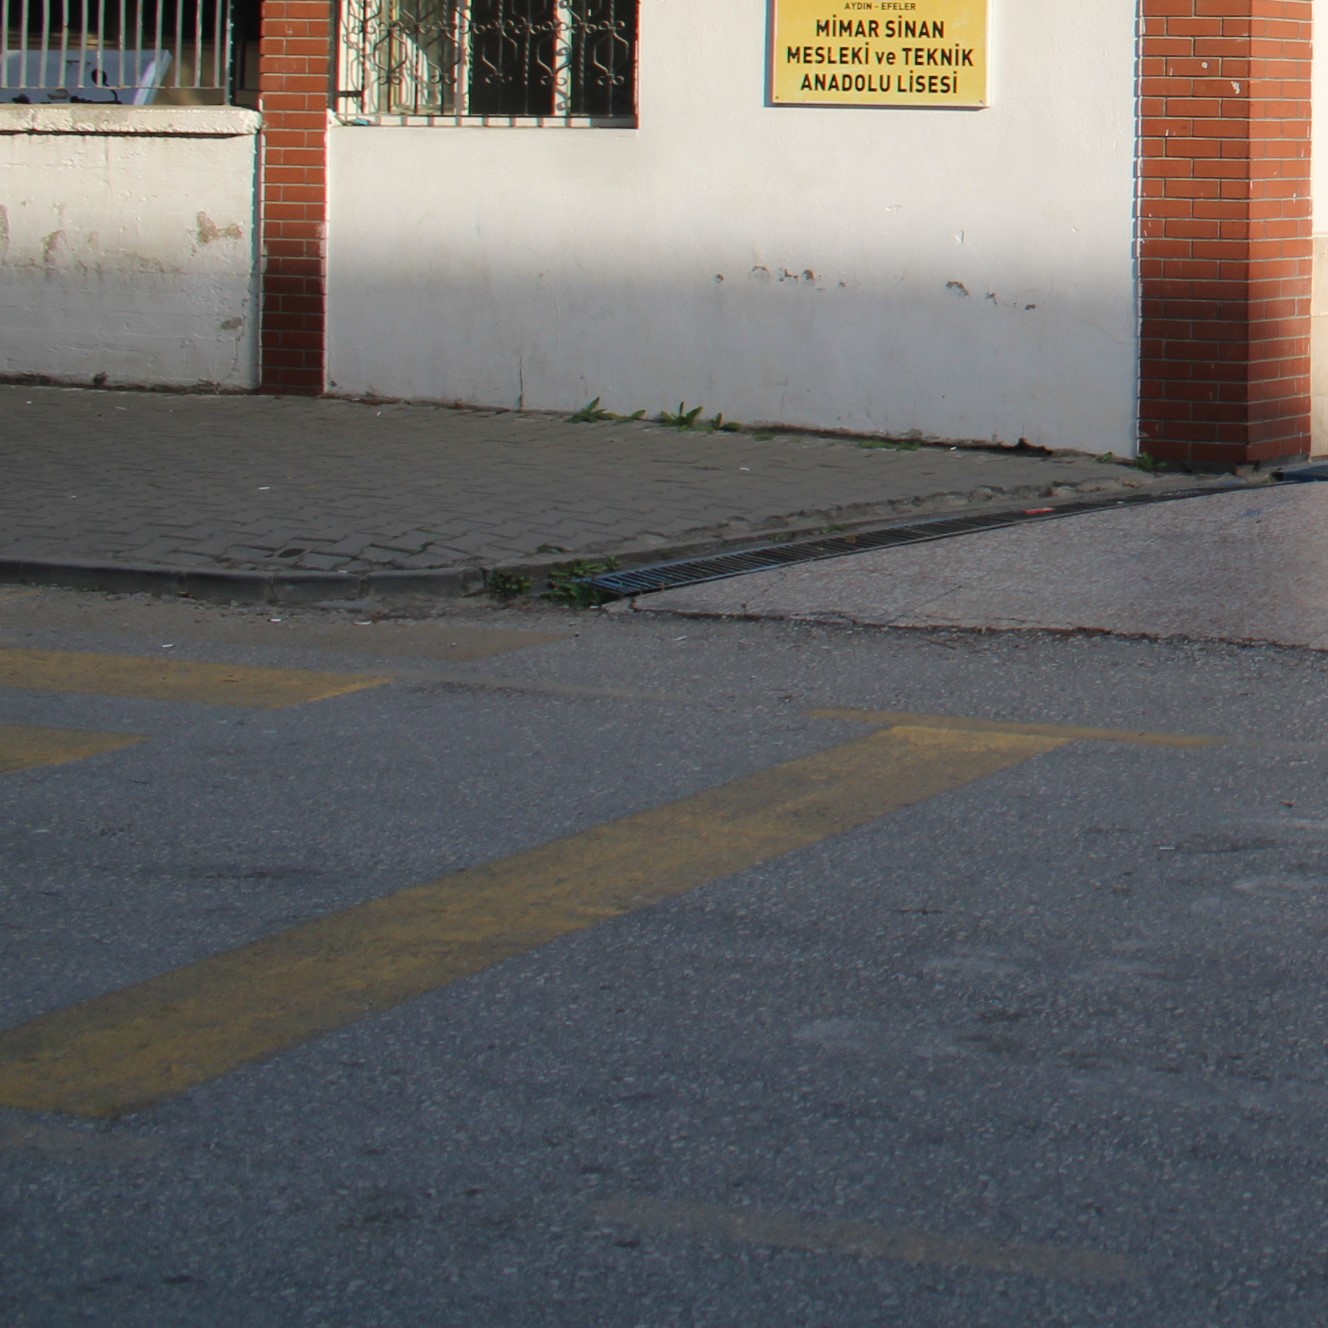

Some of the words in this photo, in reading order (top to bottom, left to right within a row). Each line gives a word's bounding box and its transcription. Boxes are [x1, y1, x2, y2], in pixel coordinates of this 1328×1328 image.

[844, 2, 872, 10] AYDIN
[816, 14, 880, 38] MİMAR
[885, 16, 945, 38] SİNAN
[786, 42, 870, 65] MESLEKİ
[875, 50, 896, 65] ve
[902, 44, 974, 66] TEKNİK
[800, 74, 891, 92] ANADOLU
[897, 70, 958, 94] LİSESİ
